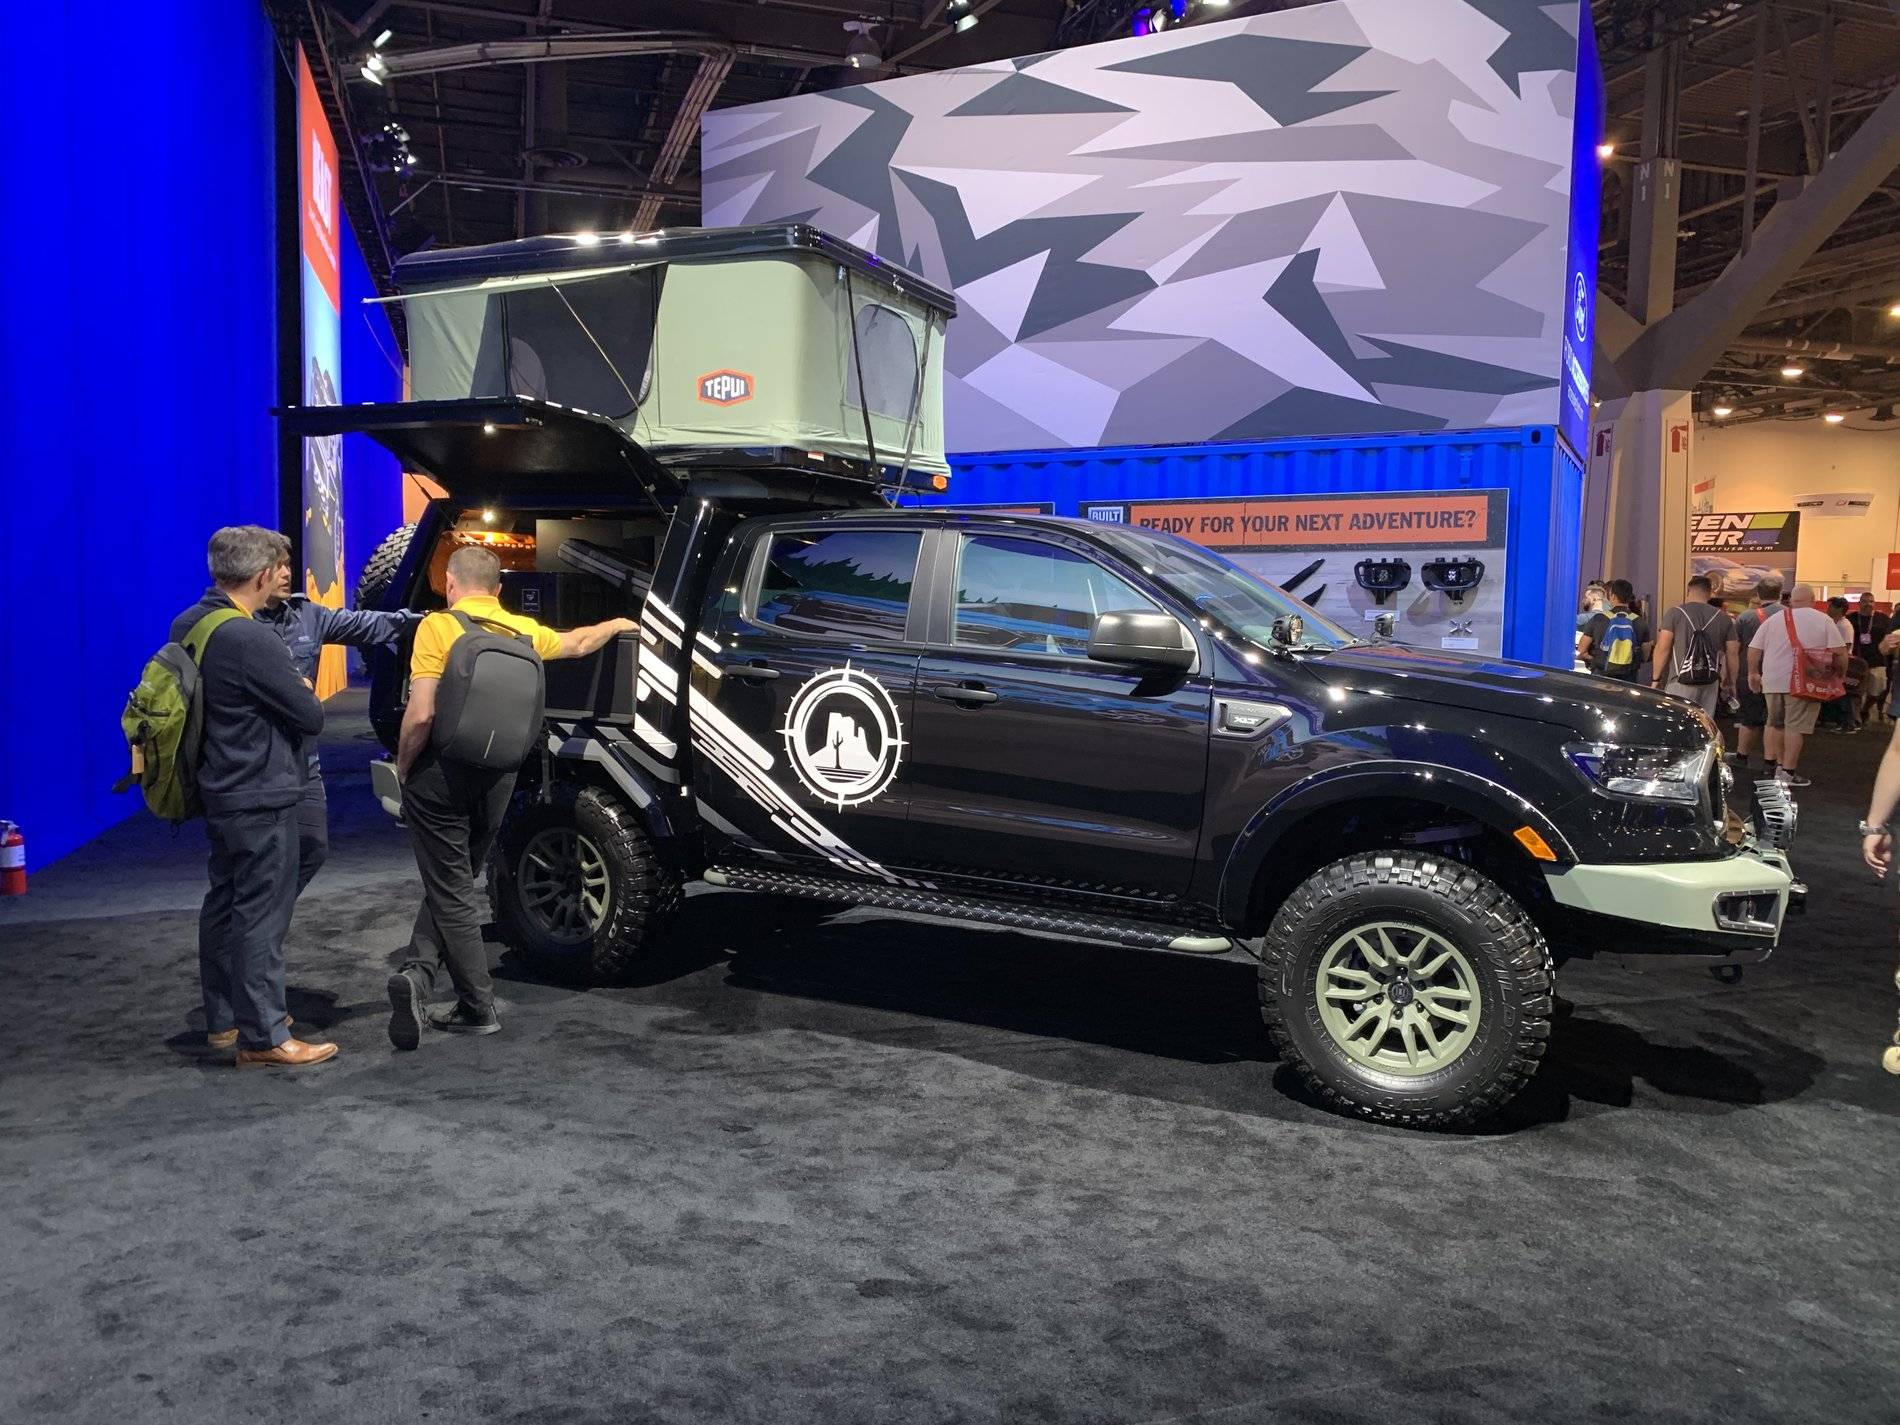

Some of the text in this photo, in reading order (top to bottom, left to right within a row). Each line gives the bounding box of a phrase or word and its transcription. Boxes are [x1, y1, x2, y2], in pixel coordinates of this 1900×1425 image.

[704, 375, 745, 400] TEPUI
[1091, 509, 1121, 521] BUILT
[1139, 509, 1477, 534] READY FOR YOUR NEXT ADVENTURE?
